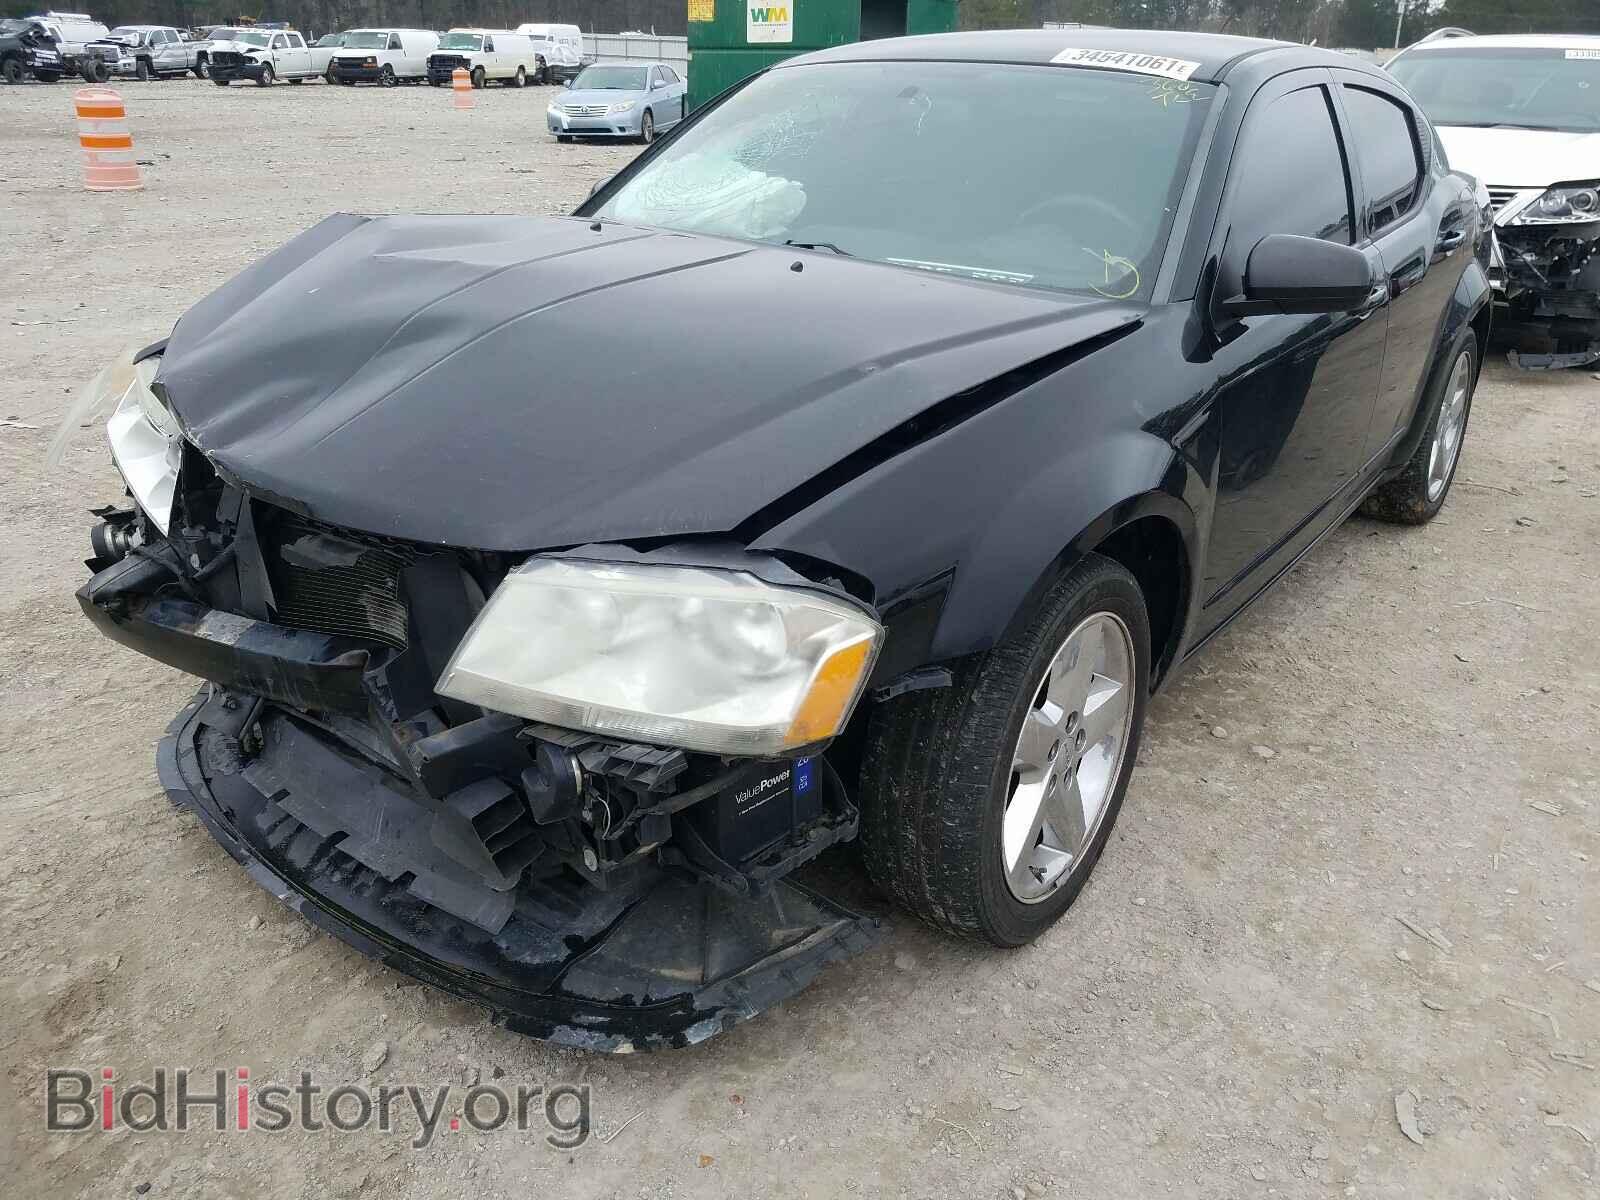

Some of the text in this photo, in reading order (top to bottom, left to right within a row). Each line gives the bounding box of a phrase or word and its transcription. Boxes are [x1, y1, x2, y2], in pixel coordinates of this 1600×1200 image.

[751, 7, 787, 22] WM
[1072, 50, 1179, 72] 34541061
[735, 770, 790, 804] ValuePower
